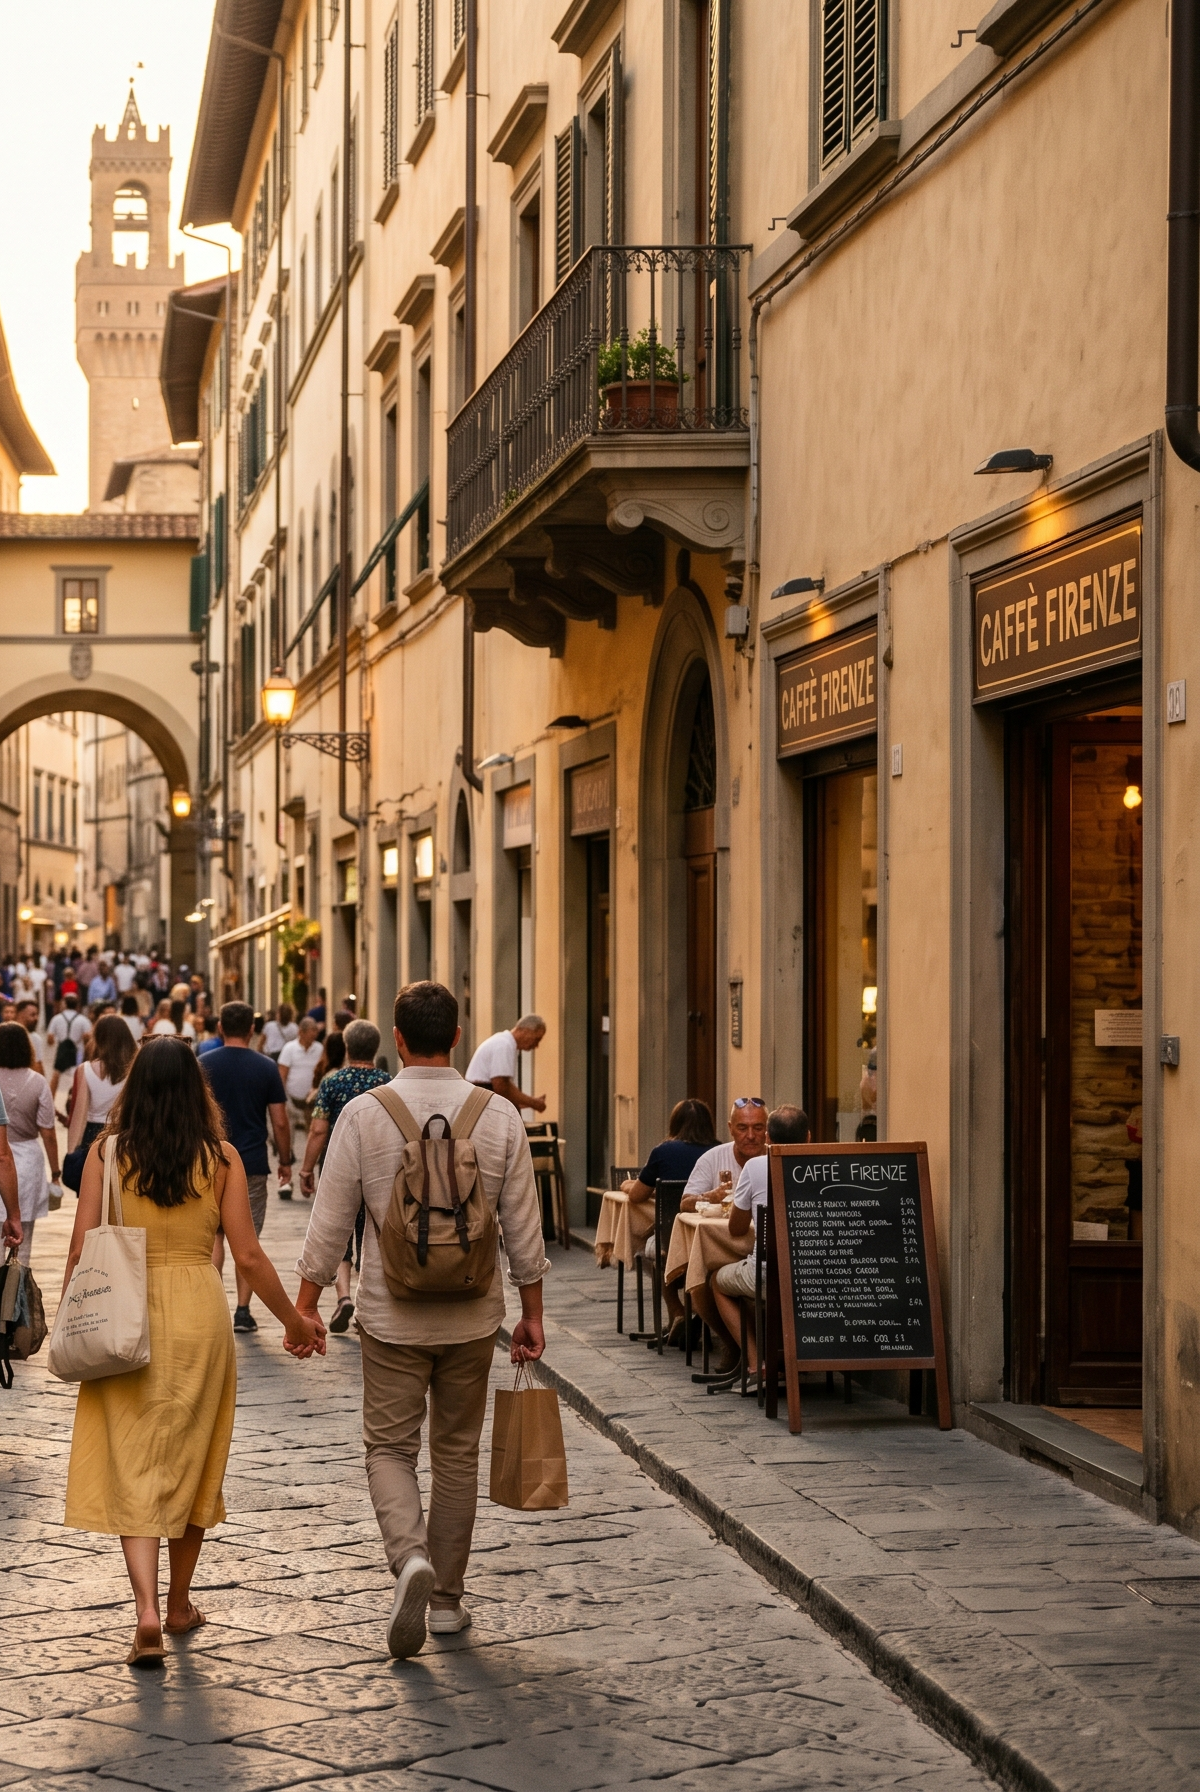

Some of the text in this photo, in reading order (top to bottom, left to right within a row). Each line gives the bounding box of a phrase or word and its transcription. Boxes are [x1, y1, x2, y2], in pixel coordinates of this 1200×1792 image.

[980, 557, 1137, 667] CAFFÈ FIRENZE
[781, 655, 875, 731] CAFFÈ FIRENZE
[850, 1163, 907, 1181] FIRENZE
